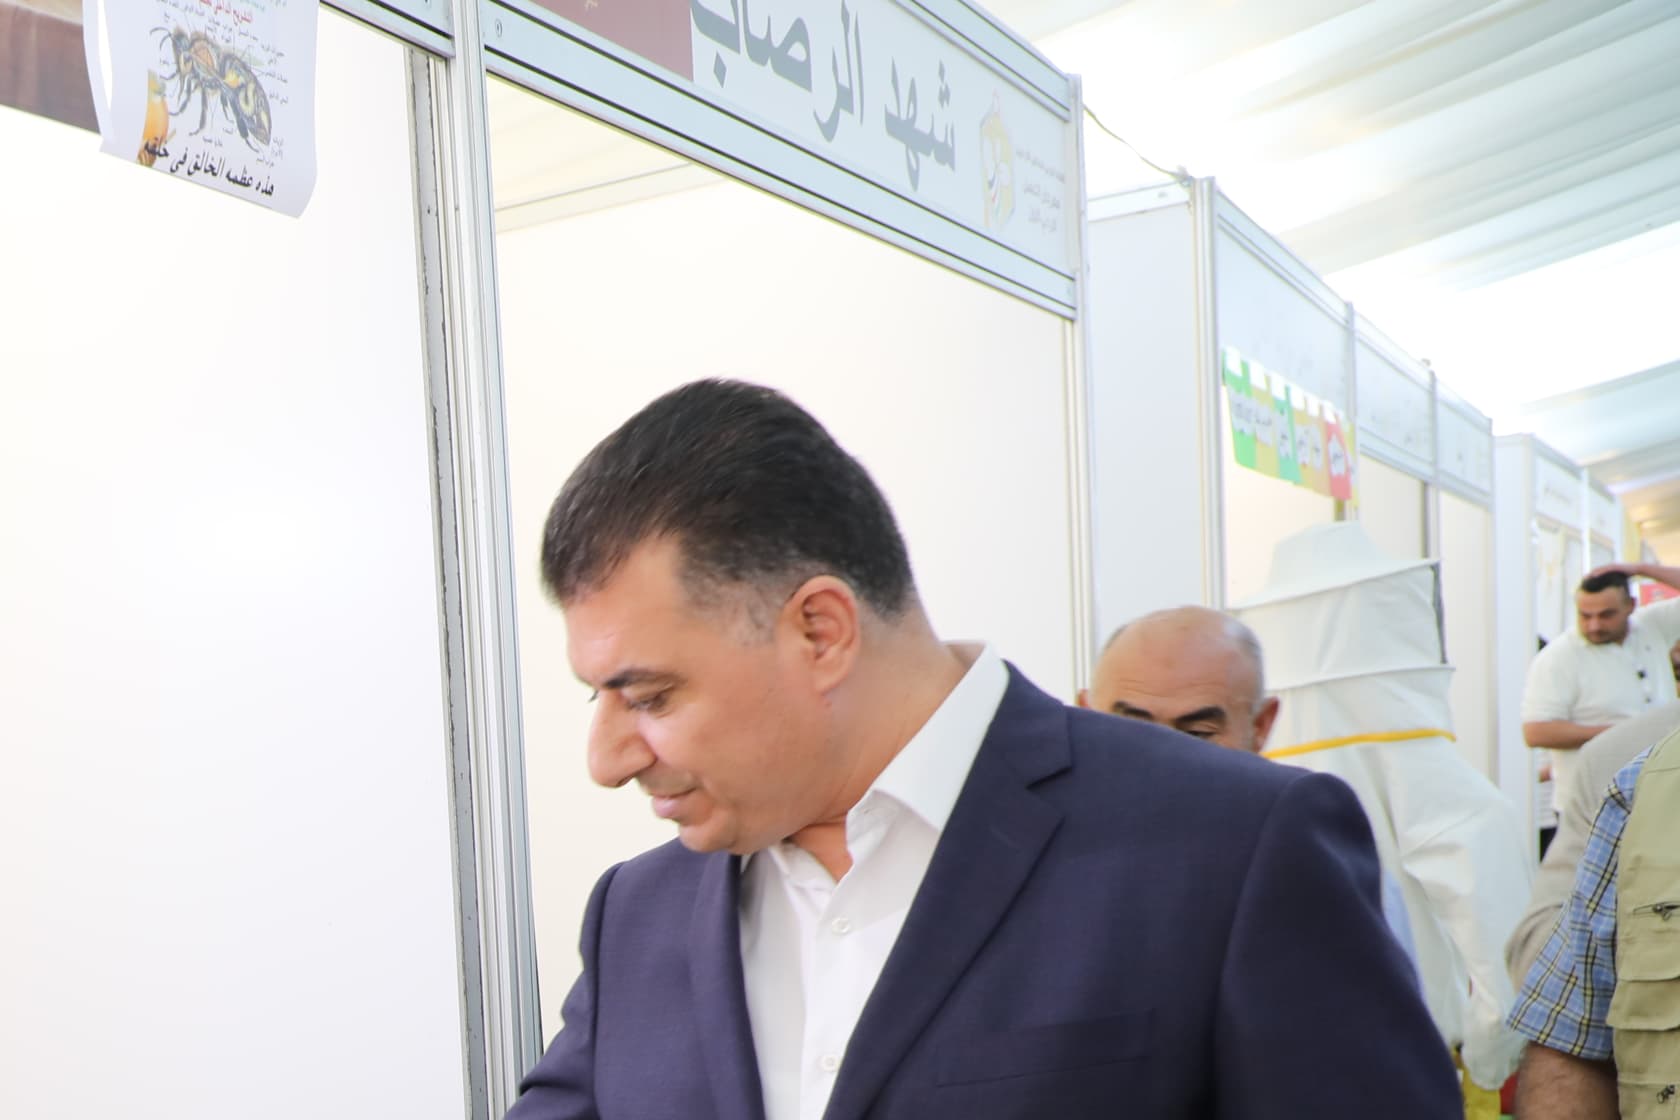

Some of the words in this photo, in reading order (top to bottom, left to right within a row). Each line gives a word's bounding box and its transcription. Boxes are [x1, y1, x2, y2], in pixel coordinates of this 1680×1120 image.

[884, 56, 956, 193] شهد
[186, 150, 226, 178] الخالق
[255, 175, 274, 196] هذه
